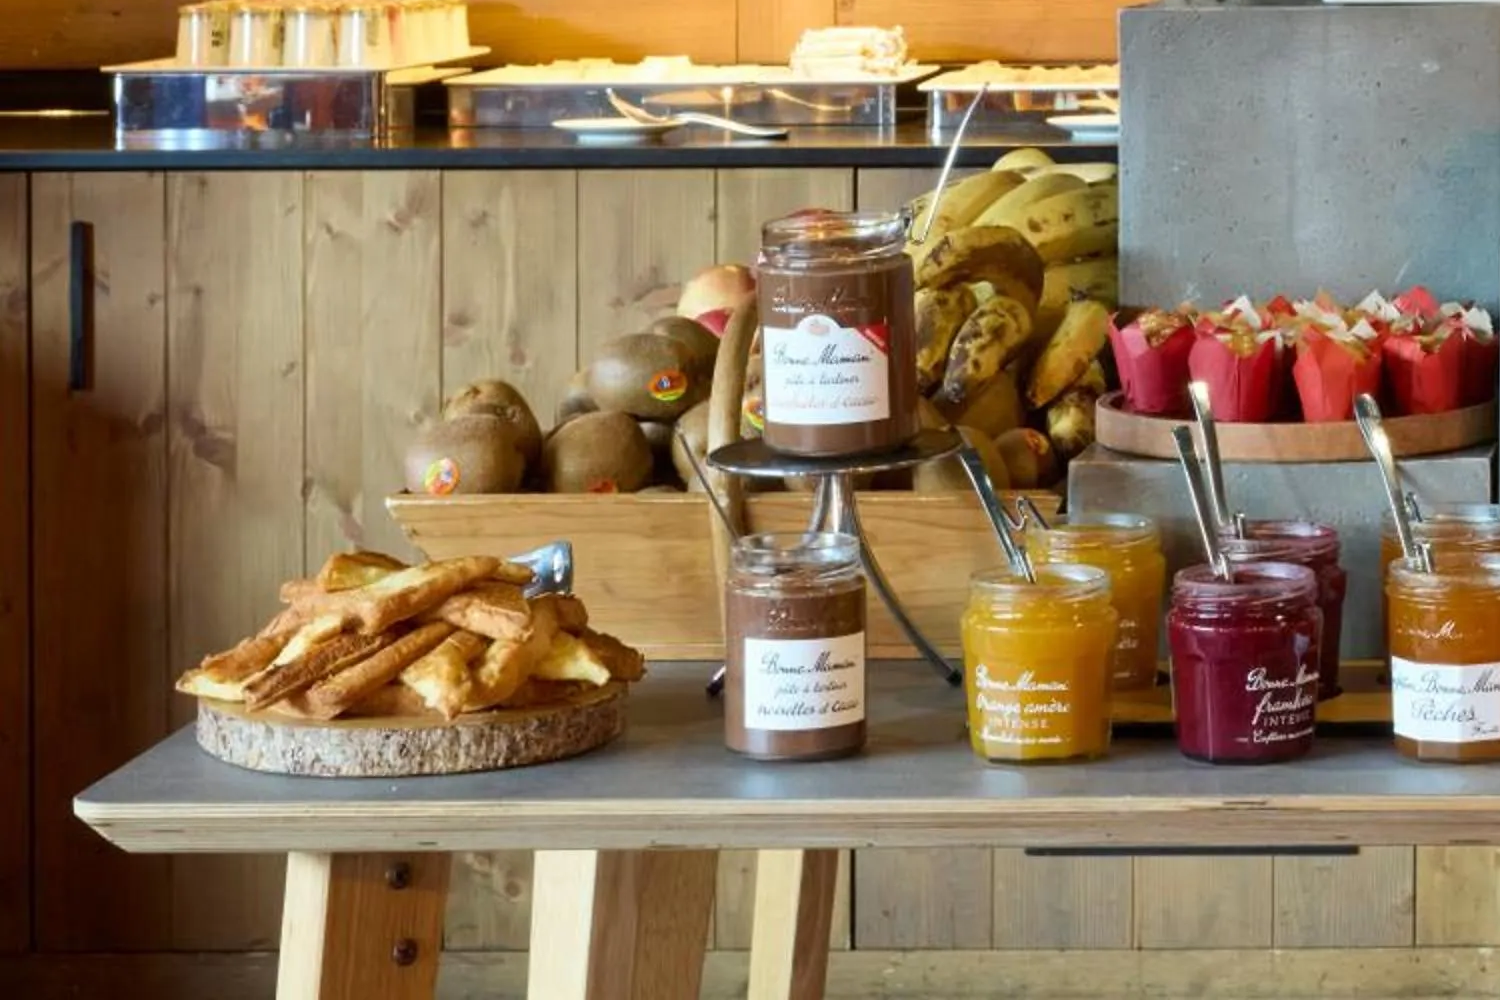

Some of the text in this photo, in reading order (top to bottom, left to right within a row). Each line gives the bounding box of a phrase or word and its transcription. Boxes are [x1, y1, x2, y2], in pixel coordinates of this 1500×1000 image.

[758, 650, 857, 675] Bonne Maman
[1245, 667, 1289, 691] Bonne
[1024, 697, 1071, 713] amère
[1410, 698, 1477, 723] Pêches
[987, 718, 1050, 729] INTENSE
